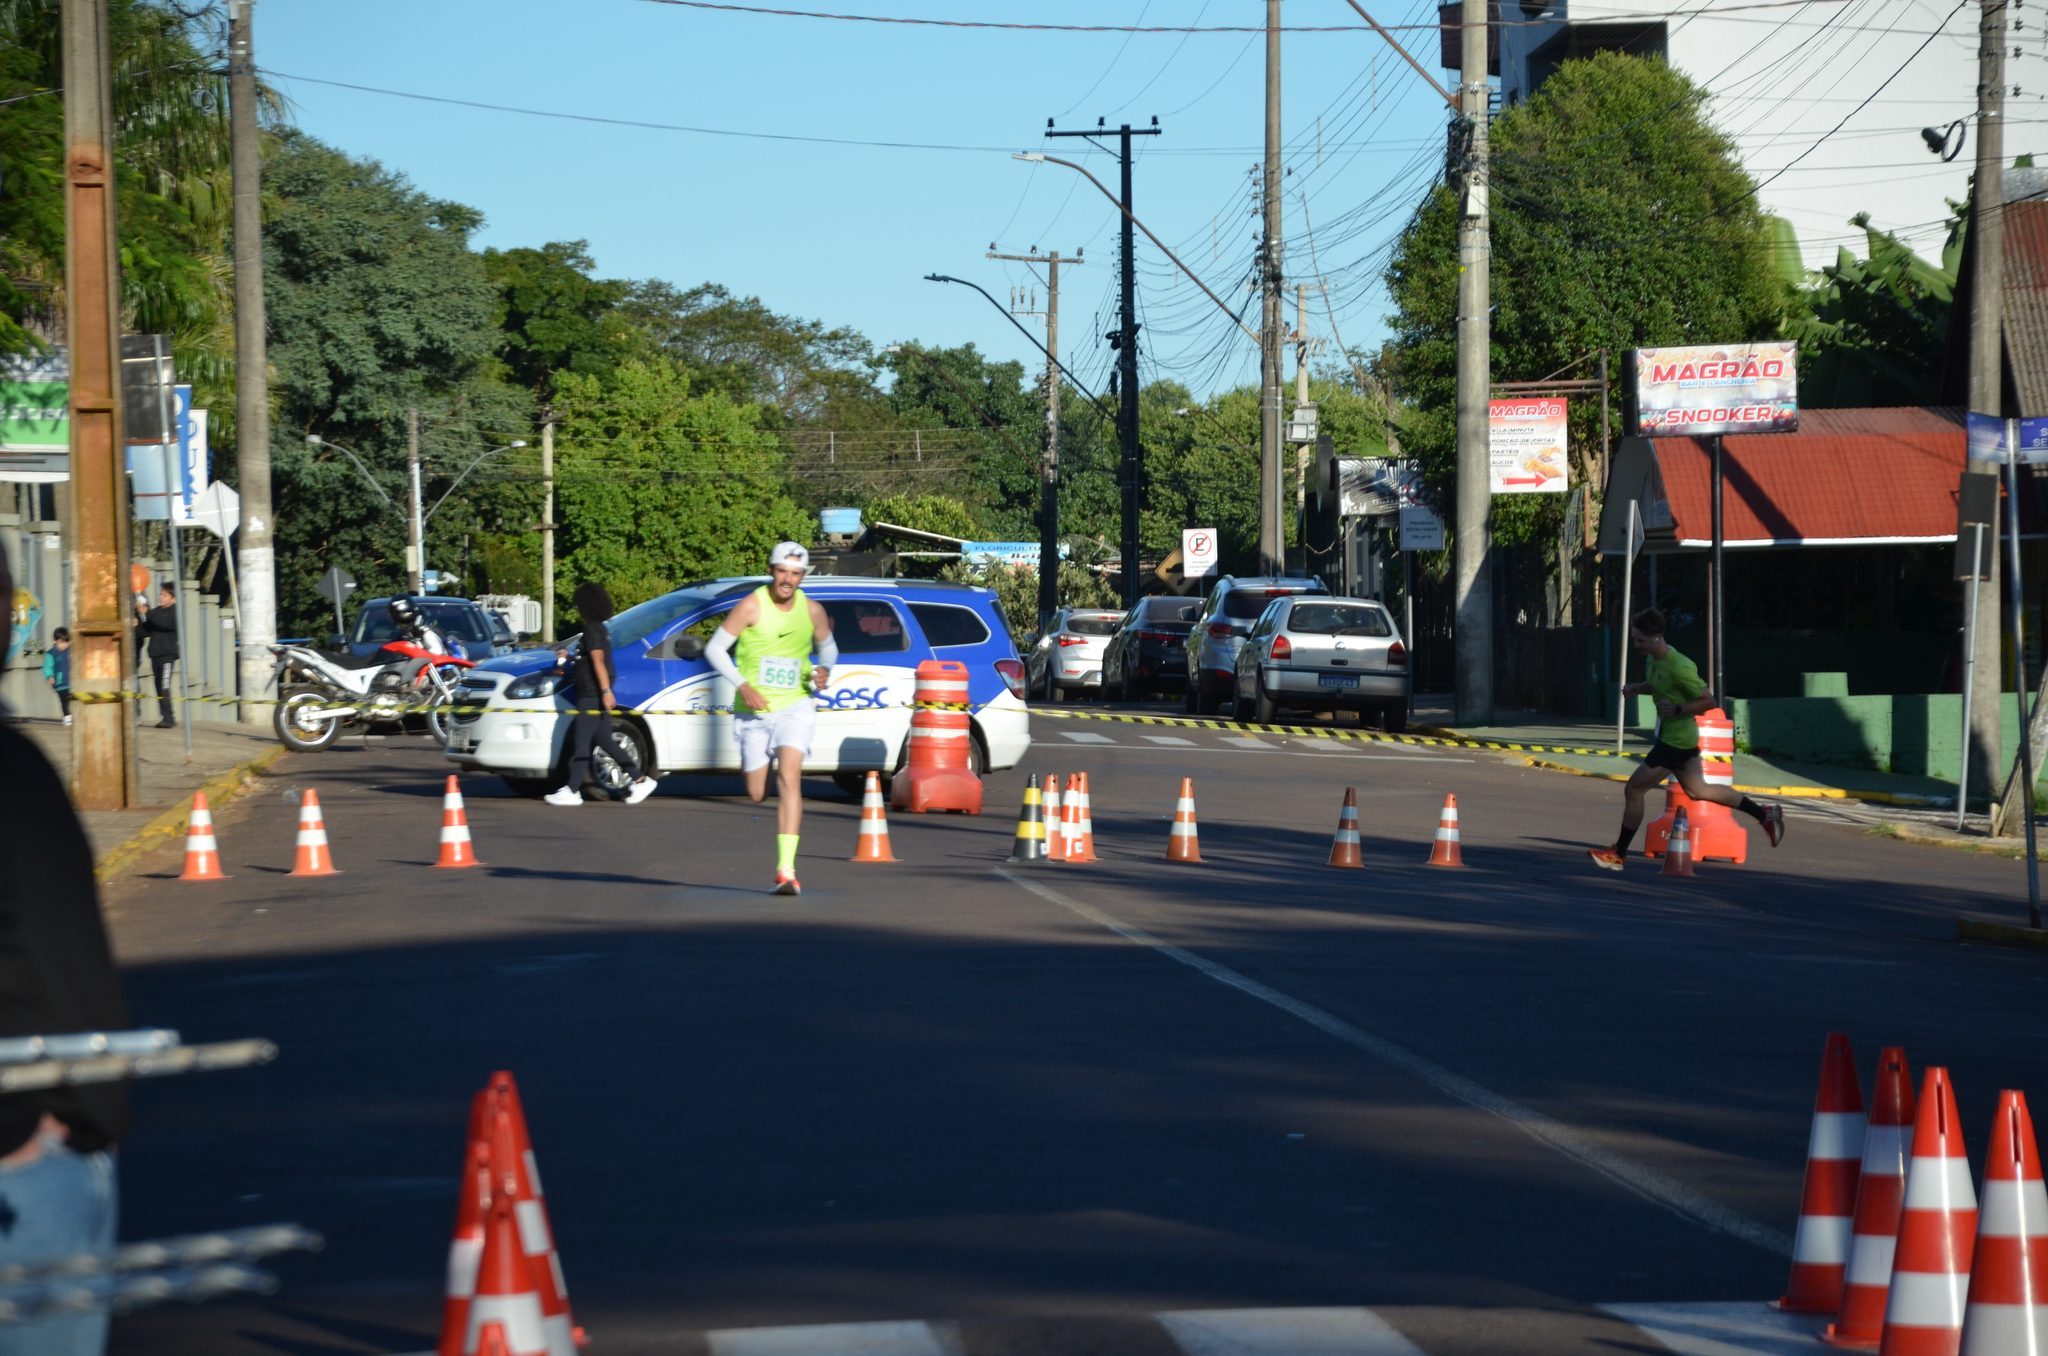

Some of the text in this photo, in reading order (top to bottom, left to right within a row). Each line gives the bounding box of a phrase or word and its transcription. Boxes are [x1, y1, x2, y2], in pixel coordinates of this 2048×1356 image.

[1652, 354, 1784, 382] MAGRÃO
[1490, 401, 1561, 417] MAGRÃO
[1666, 406, 1773, 425] SNOOKER
[1491, 437, 1519, 445] PORÇÃO
[765, 666, 796, 686] 569
